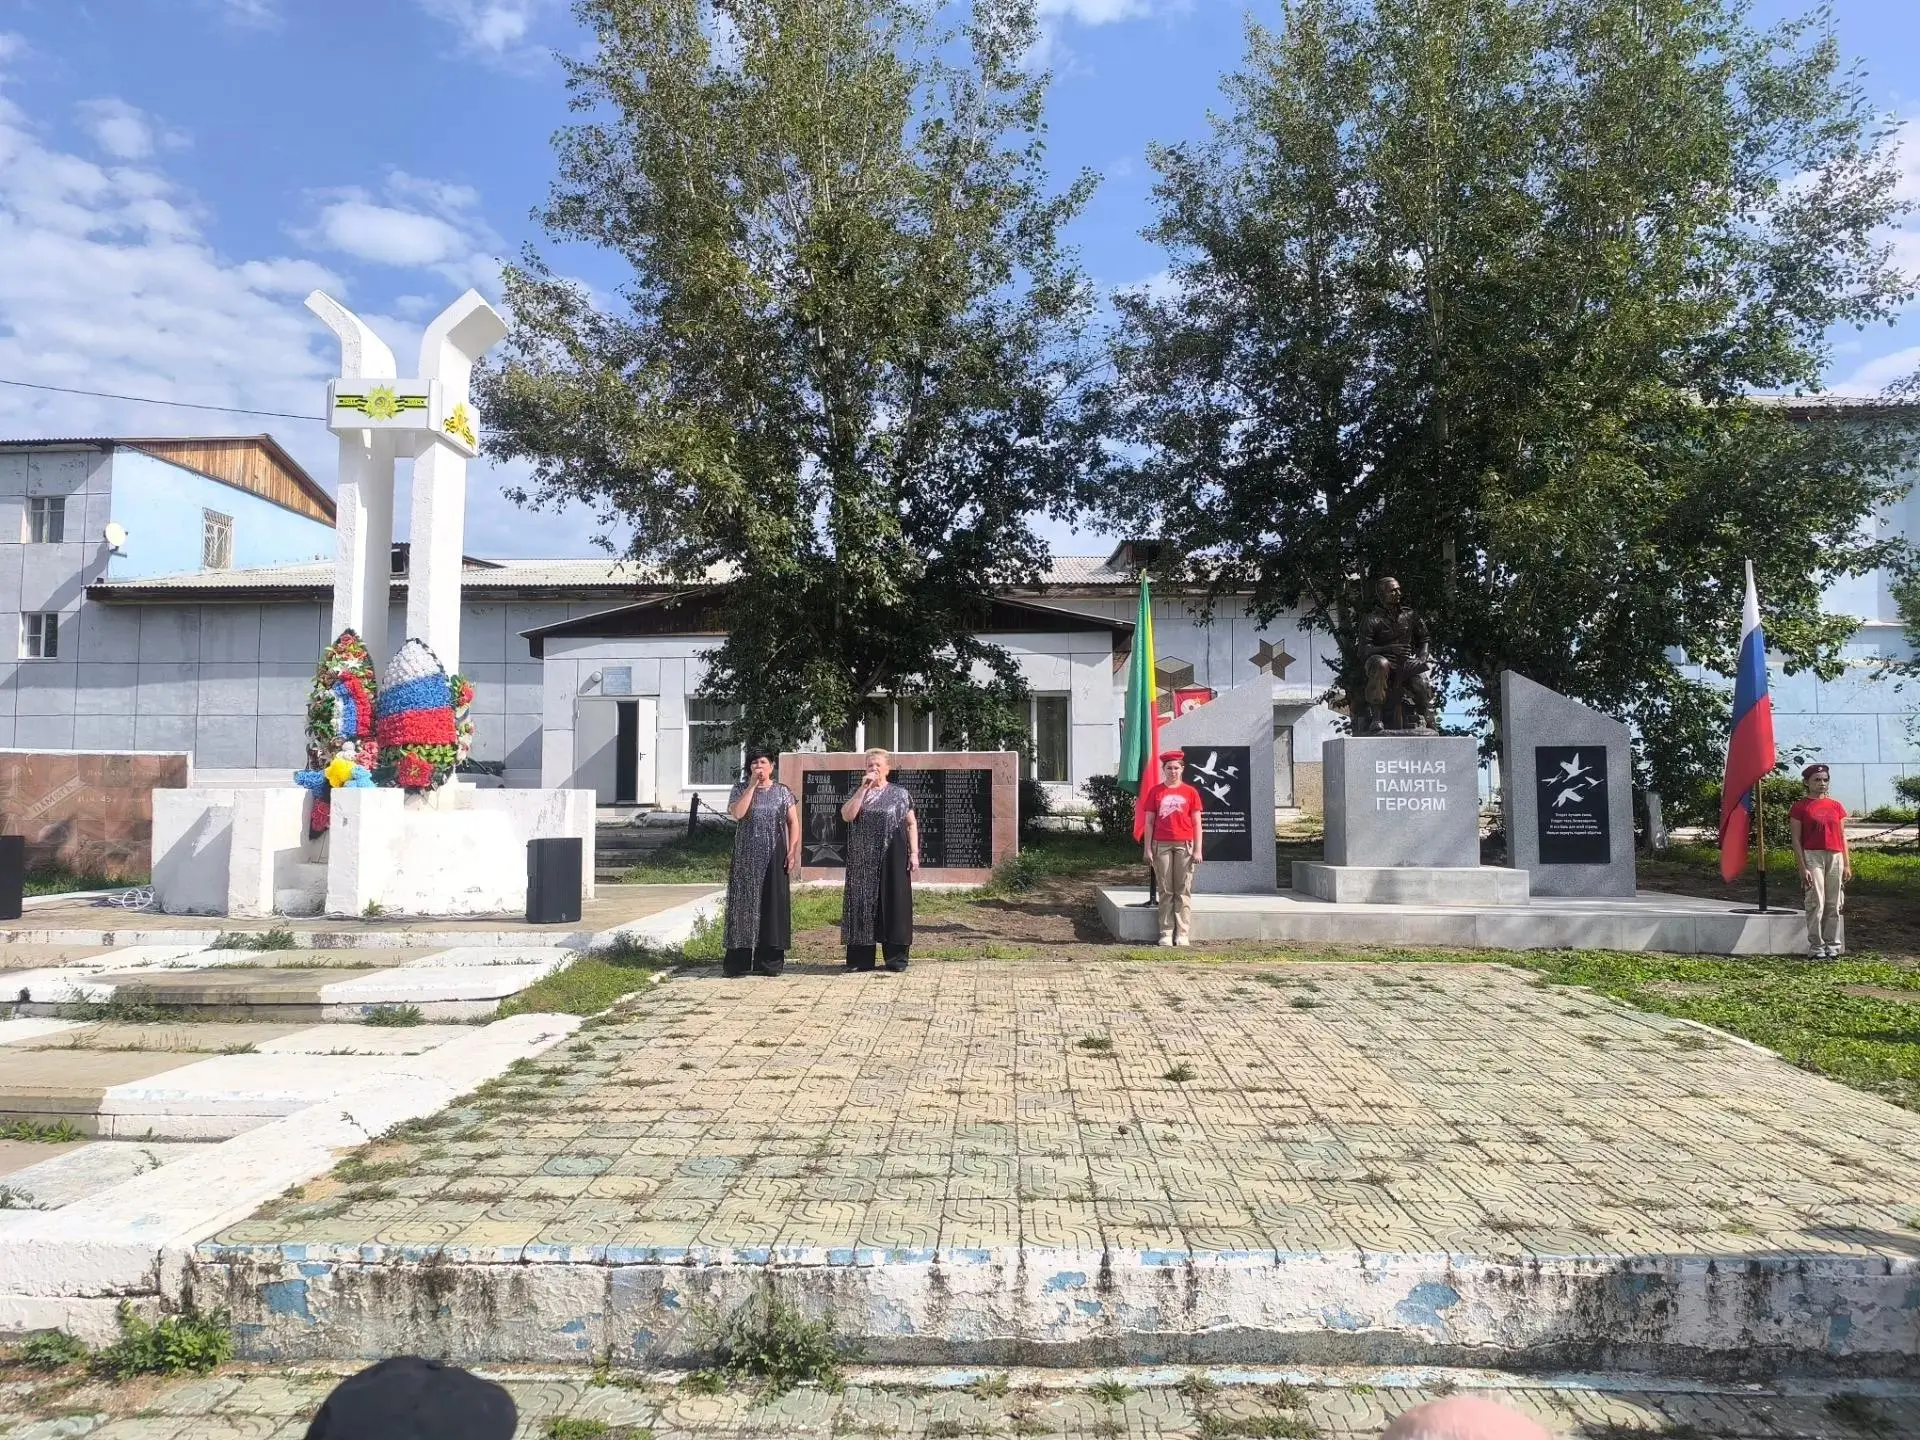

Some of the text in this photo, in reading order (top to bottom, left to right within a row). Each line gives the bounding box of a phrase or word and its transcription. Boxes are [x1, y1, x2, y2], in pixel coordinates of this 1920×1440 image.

[1375, 760, 1446, 774] ВЕЧНАЯ
[1375, 779, 1448, 792] ПАМЯТЬ
[1376, 797, 1446, 811] ГЕРОЯМ
